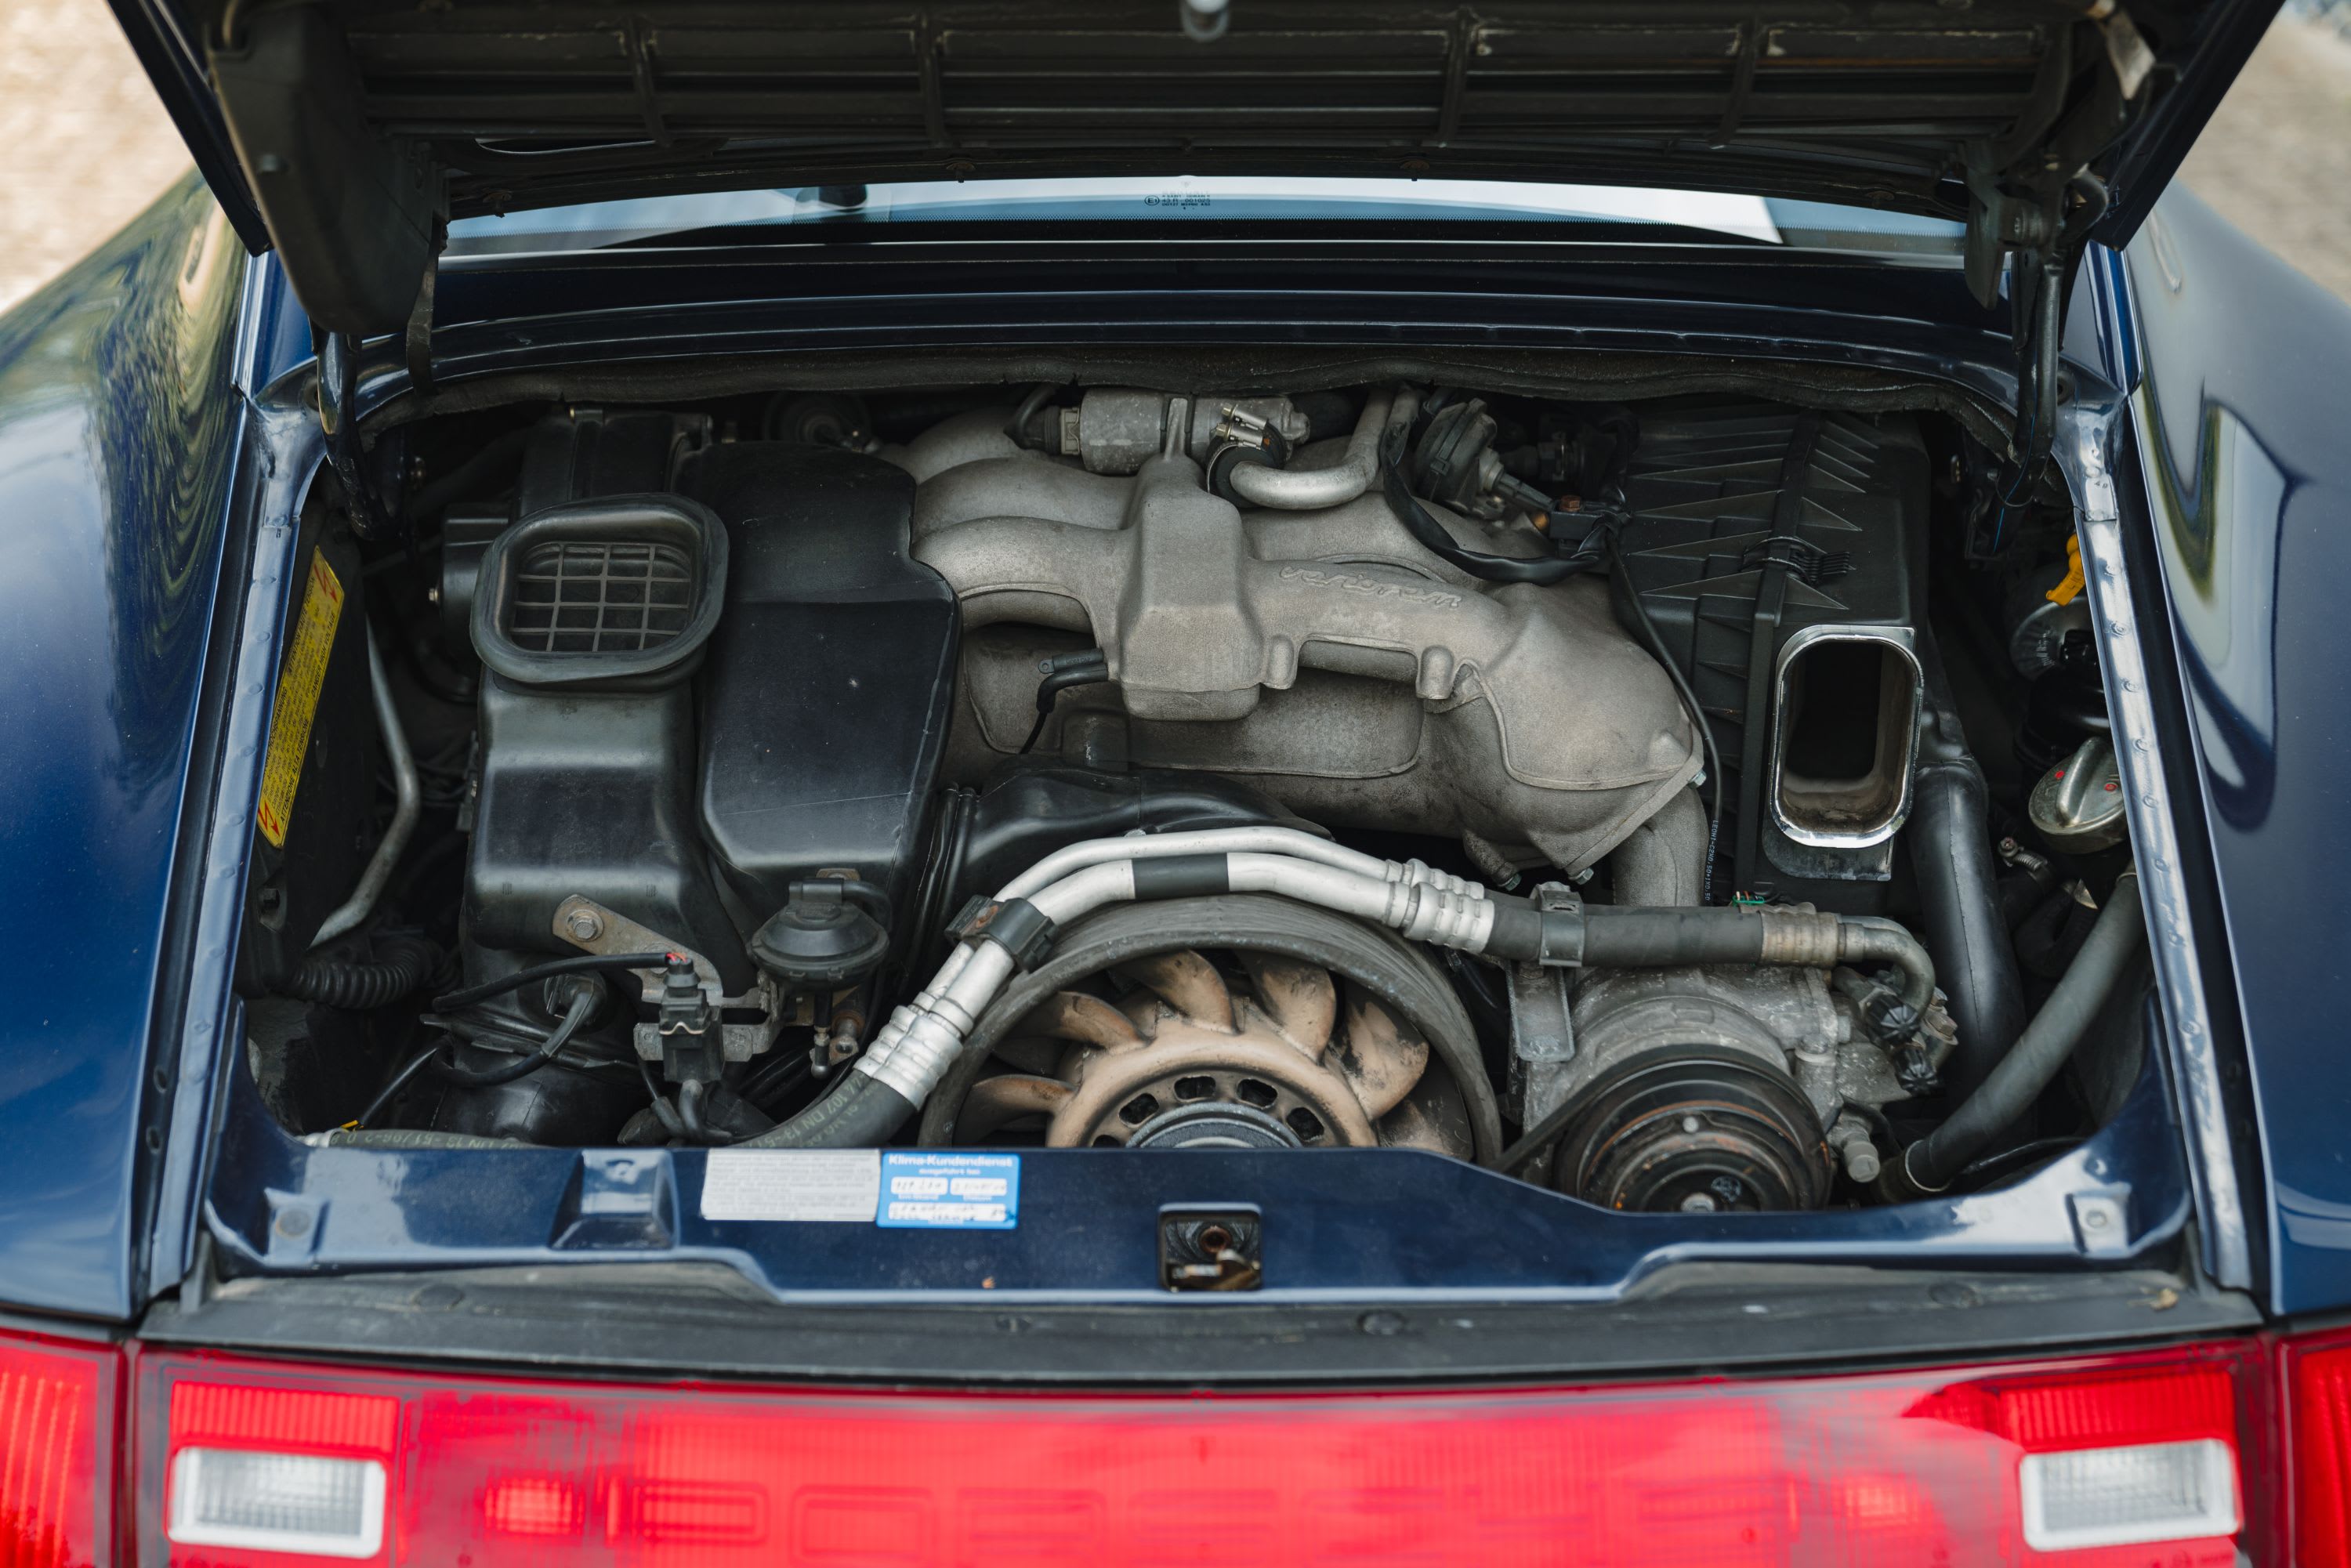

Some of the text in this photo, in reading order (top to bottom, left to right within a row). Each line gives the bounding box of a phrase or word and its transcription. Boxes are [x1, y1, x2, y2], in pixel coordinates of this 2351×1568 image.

[281, 777, 295, 821] ATTENZIONE
[292, 756, 300, 775] ALTA
[297, 717, 310, 755] TENSIONE
[802, 1110, 825, 1130] DN
[888, 1153, 1012, 1167] Klima-Kundendienst
